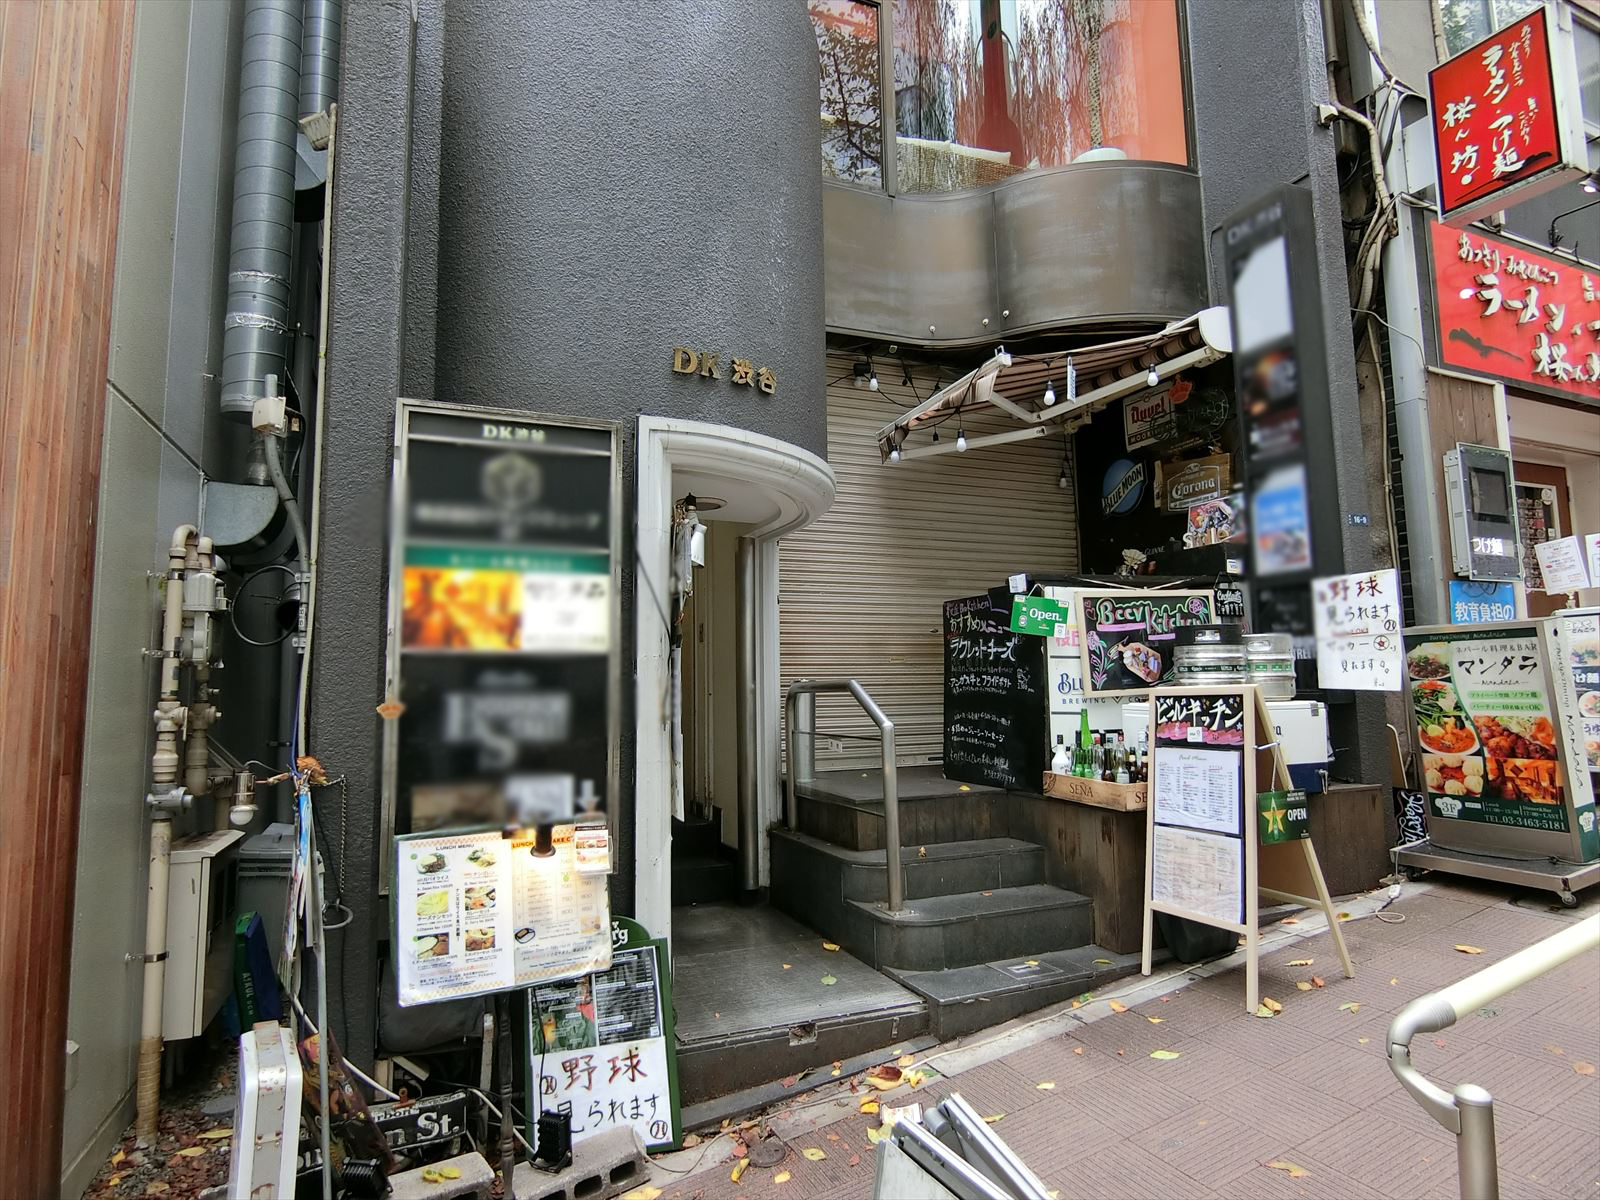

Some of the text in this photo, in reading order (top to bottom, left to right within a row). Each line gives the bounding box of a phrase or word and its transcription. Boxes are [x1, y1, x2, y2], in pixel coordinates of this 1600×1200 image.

[672, 347, 778, 395] DK 渋谷
[1101, 463, 1144, 514] BLUE MOON
[1172, 477, 1216, 499] Corona
[1471, 537, 1504, 556] つけ麺
[1328, 576, 1383, 601] 野球
[1455, 601, 1514, 622] 教育負担の
[950, 636, 1019, 661] ラクレットチーズ
[1458, 655, 1538, 676] マンダラ
[1287, 807, 1307, 821] OPEN
[1441, 801, 1458, 813] 3F
[512, 841, 534, 849] LUNCH
[562, 1049, 648, 1091] 野球
[417, 1111, 459, 1141] St.
